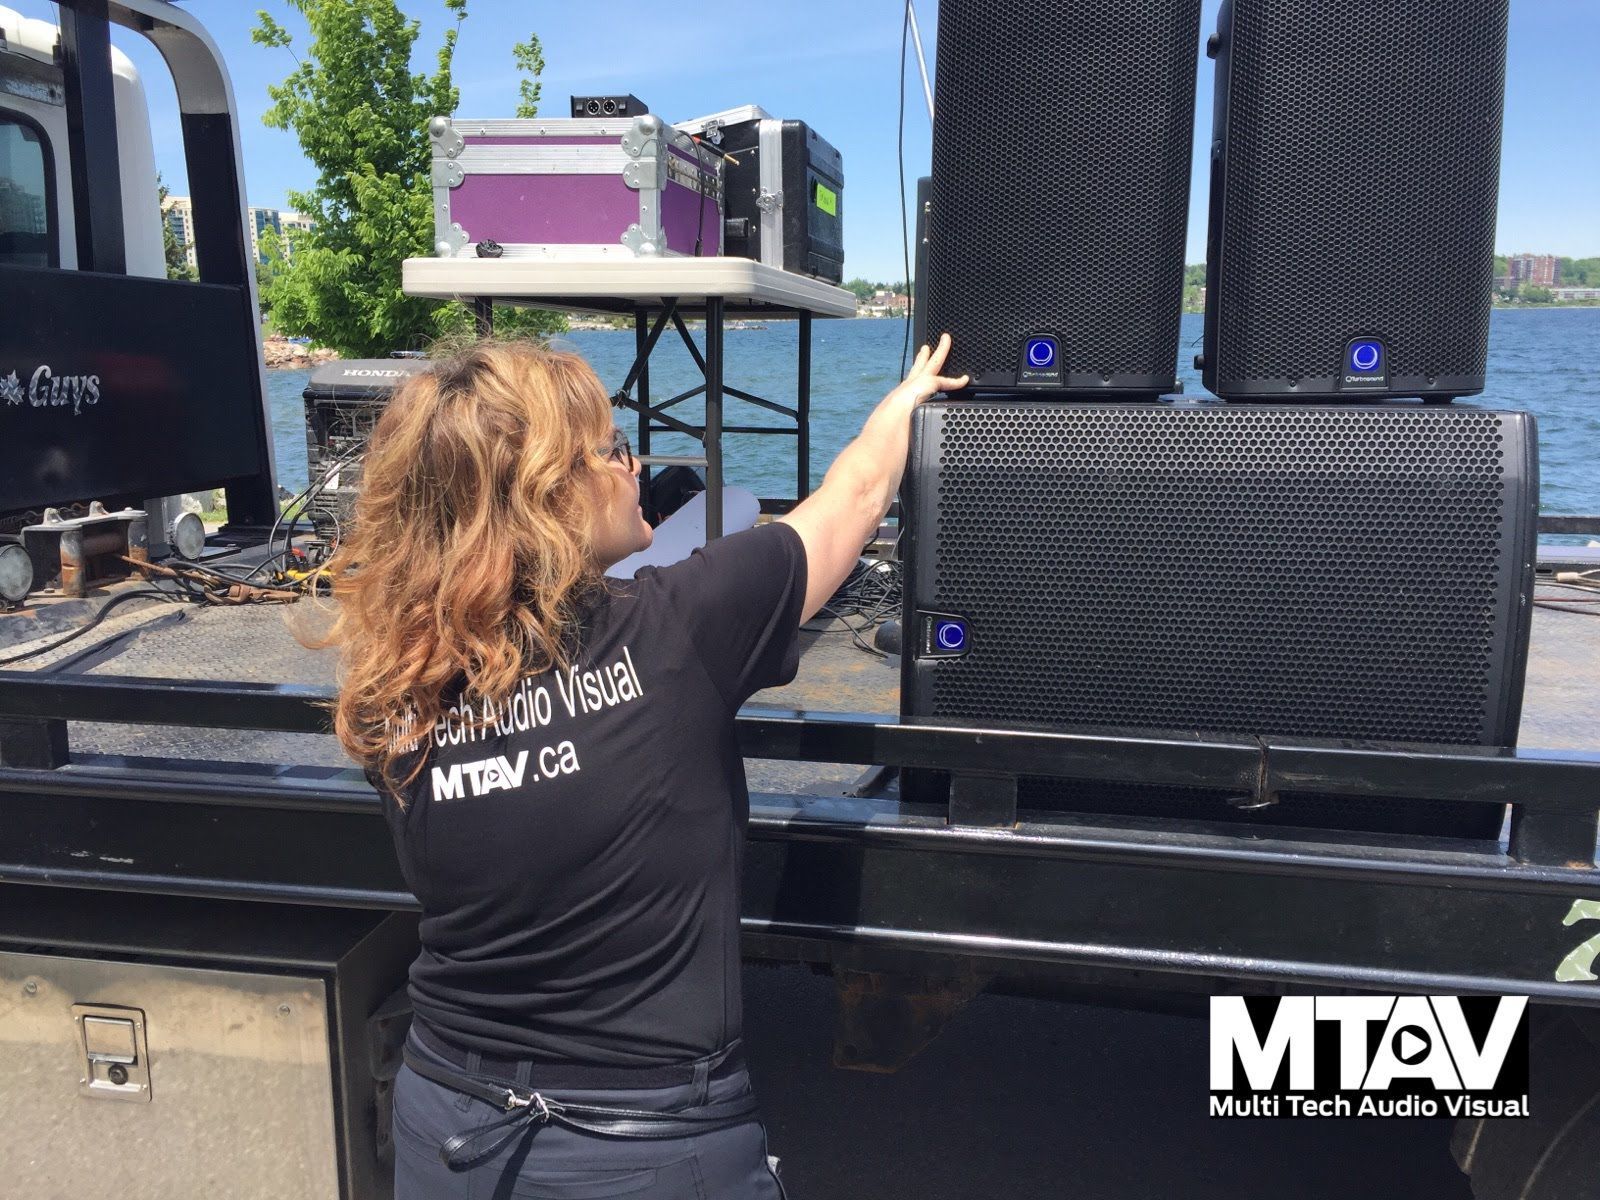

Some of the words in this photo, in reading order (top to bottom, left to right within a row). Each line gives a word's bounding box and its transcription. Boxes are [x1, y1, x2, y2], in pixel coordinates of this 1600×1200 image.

[28, 365, 100, 416] Guys
[481, 677, 552, 740] Audio
[555, 646, 643, 717] Visual
